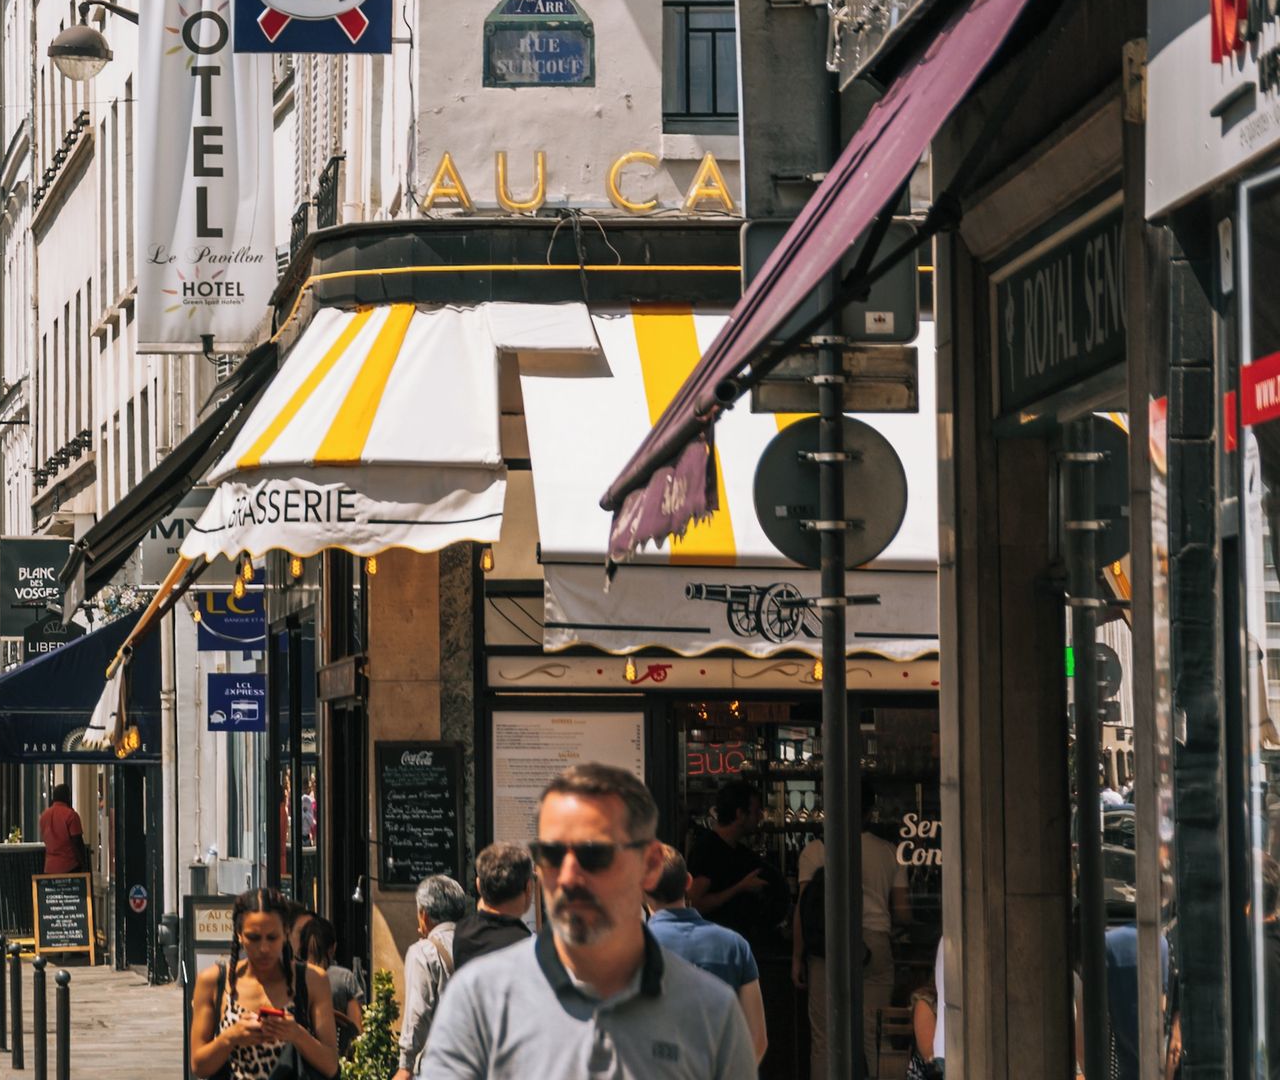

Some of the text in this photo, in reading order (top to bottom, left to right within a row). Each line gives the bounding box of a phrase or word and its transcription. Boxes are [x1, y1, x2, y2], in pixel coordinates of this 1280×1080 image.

[520, 38, 560, 53] RUE
[496, 59, 584, 74] SURCOUF
[419, 150, 547, 213] AU
[146, 243, 264, 265] Le Pavillon
[183, 281, 245, 297] HOTEL
[1024, 253, 1078, 377] ROYAL
[18, 567, 55, 581] BLANC
[14, 587, 60, 599] VOSGES
[206, 591, 266, 614] LC
[28, 641, 70, 653] LIBER
[23, 743, 57, 752] PAON
[899, 812, 943, 838] Ser
[895, 840, 943, 866] Con
[208, 911, 221, 920] AU
[199, 923, 218, 933] DES
